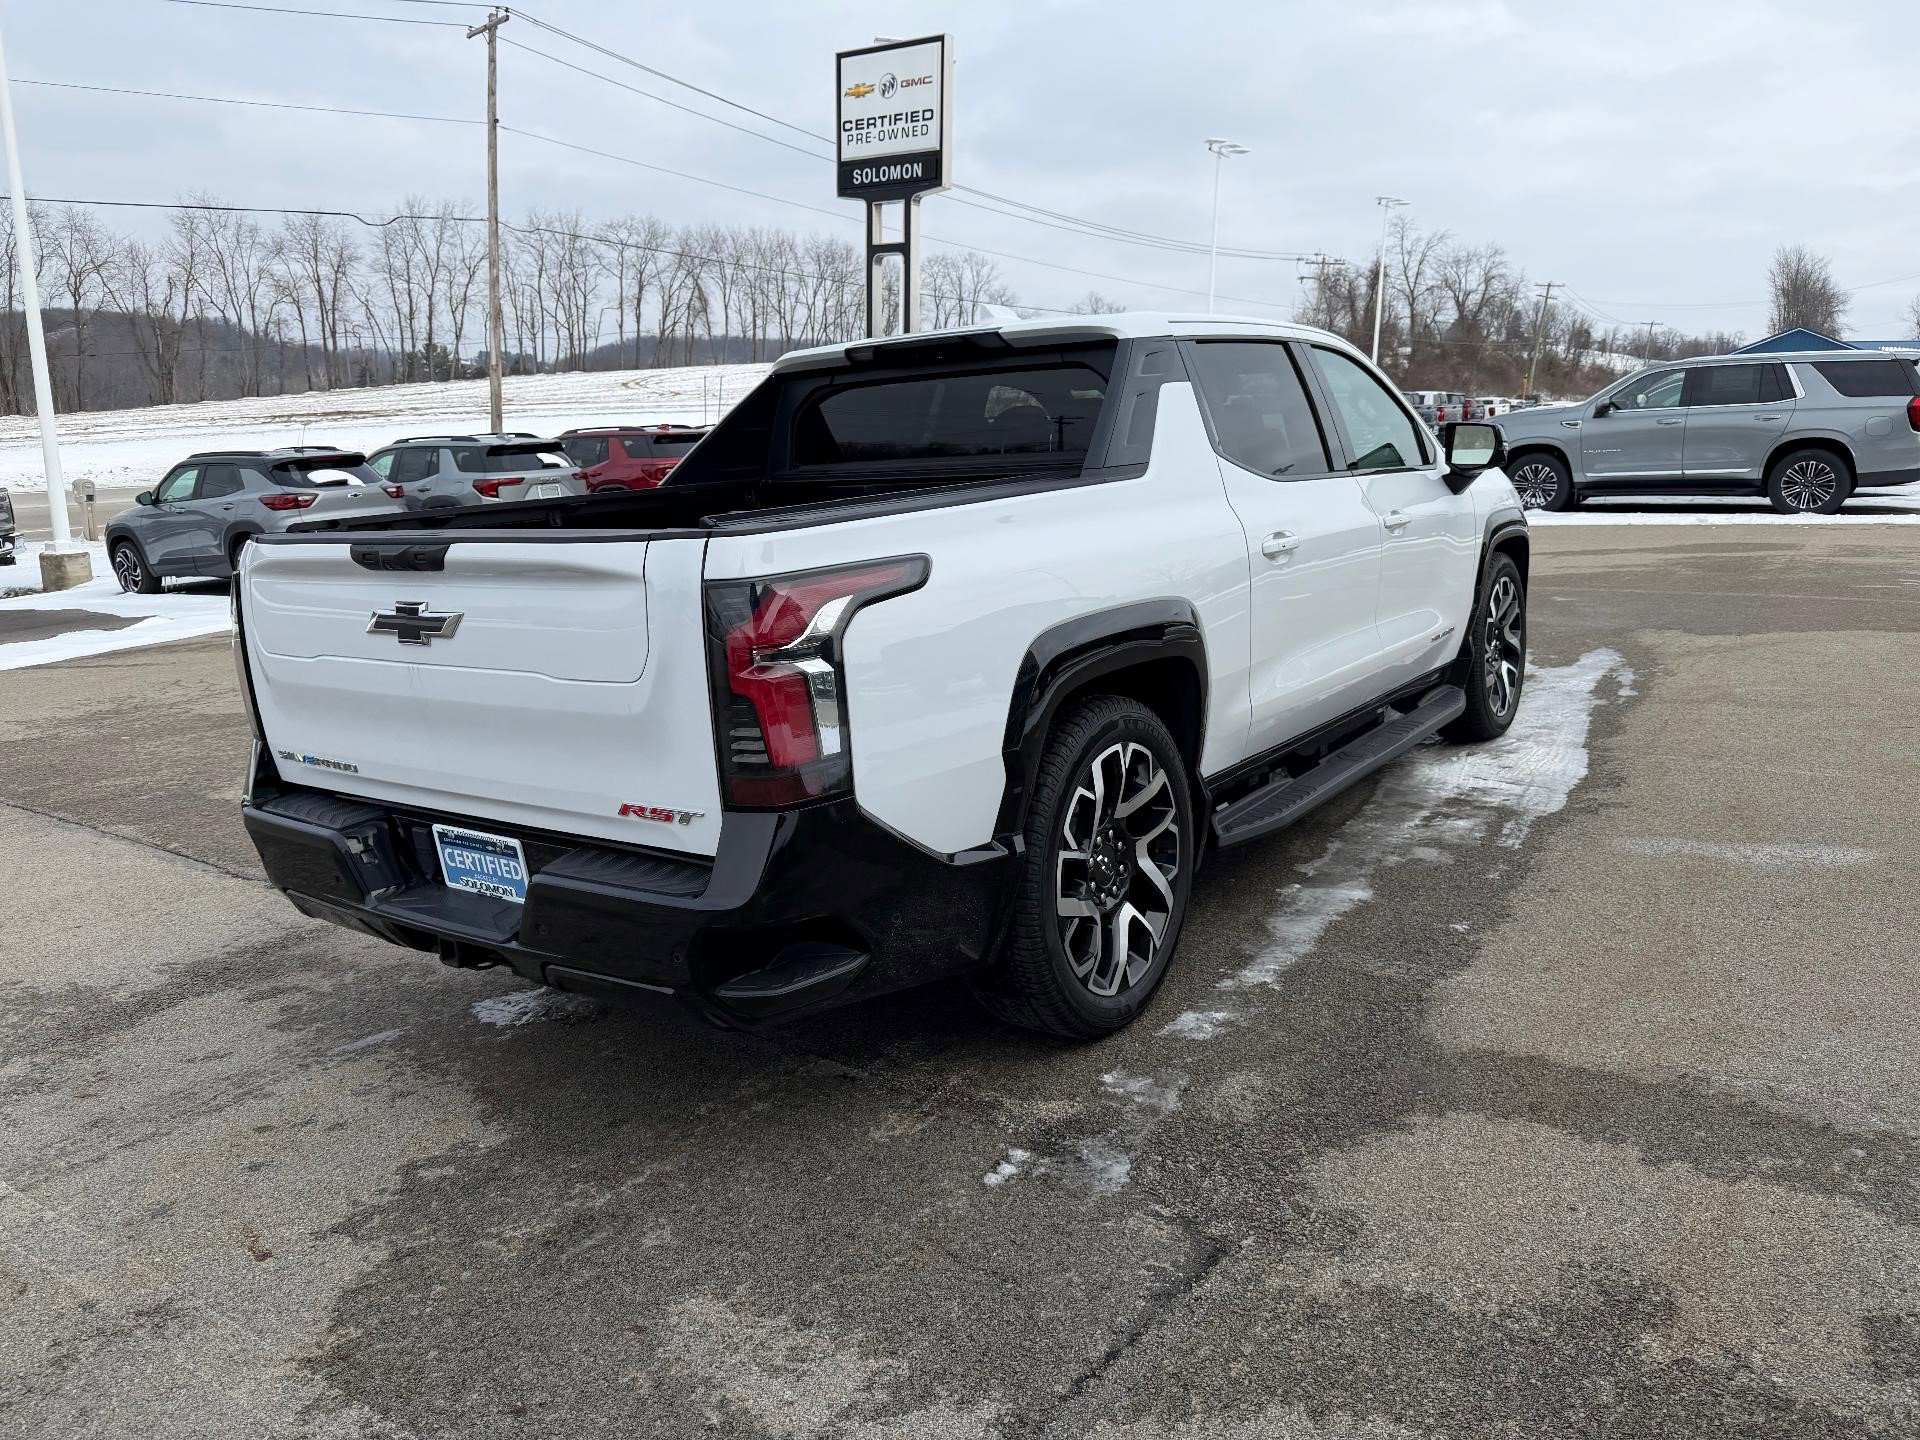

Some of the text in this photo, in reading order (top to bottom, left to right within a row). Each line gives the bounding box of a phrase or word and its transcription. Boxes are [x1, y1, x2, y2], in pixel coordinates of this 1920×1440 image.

[900, 75, 933, 88] GMC
[842, 108, 934, 132] CERTIFIED
[847, 124, 929, 146] PRE-OWNED
[852, 162, 923, 185] SOLOMON
[617, 803, 705, 826] RST
[444, 847, 522, 880] CERTIFIED
[460, 876, 516, 897] SOLOMON
